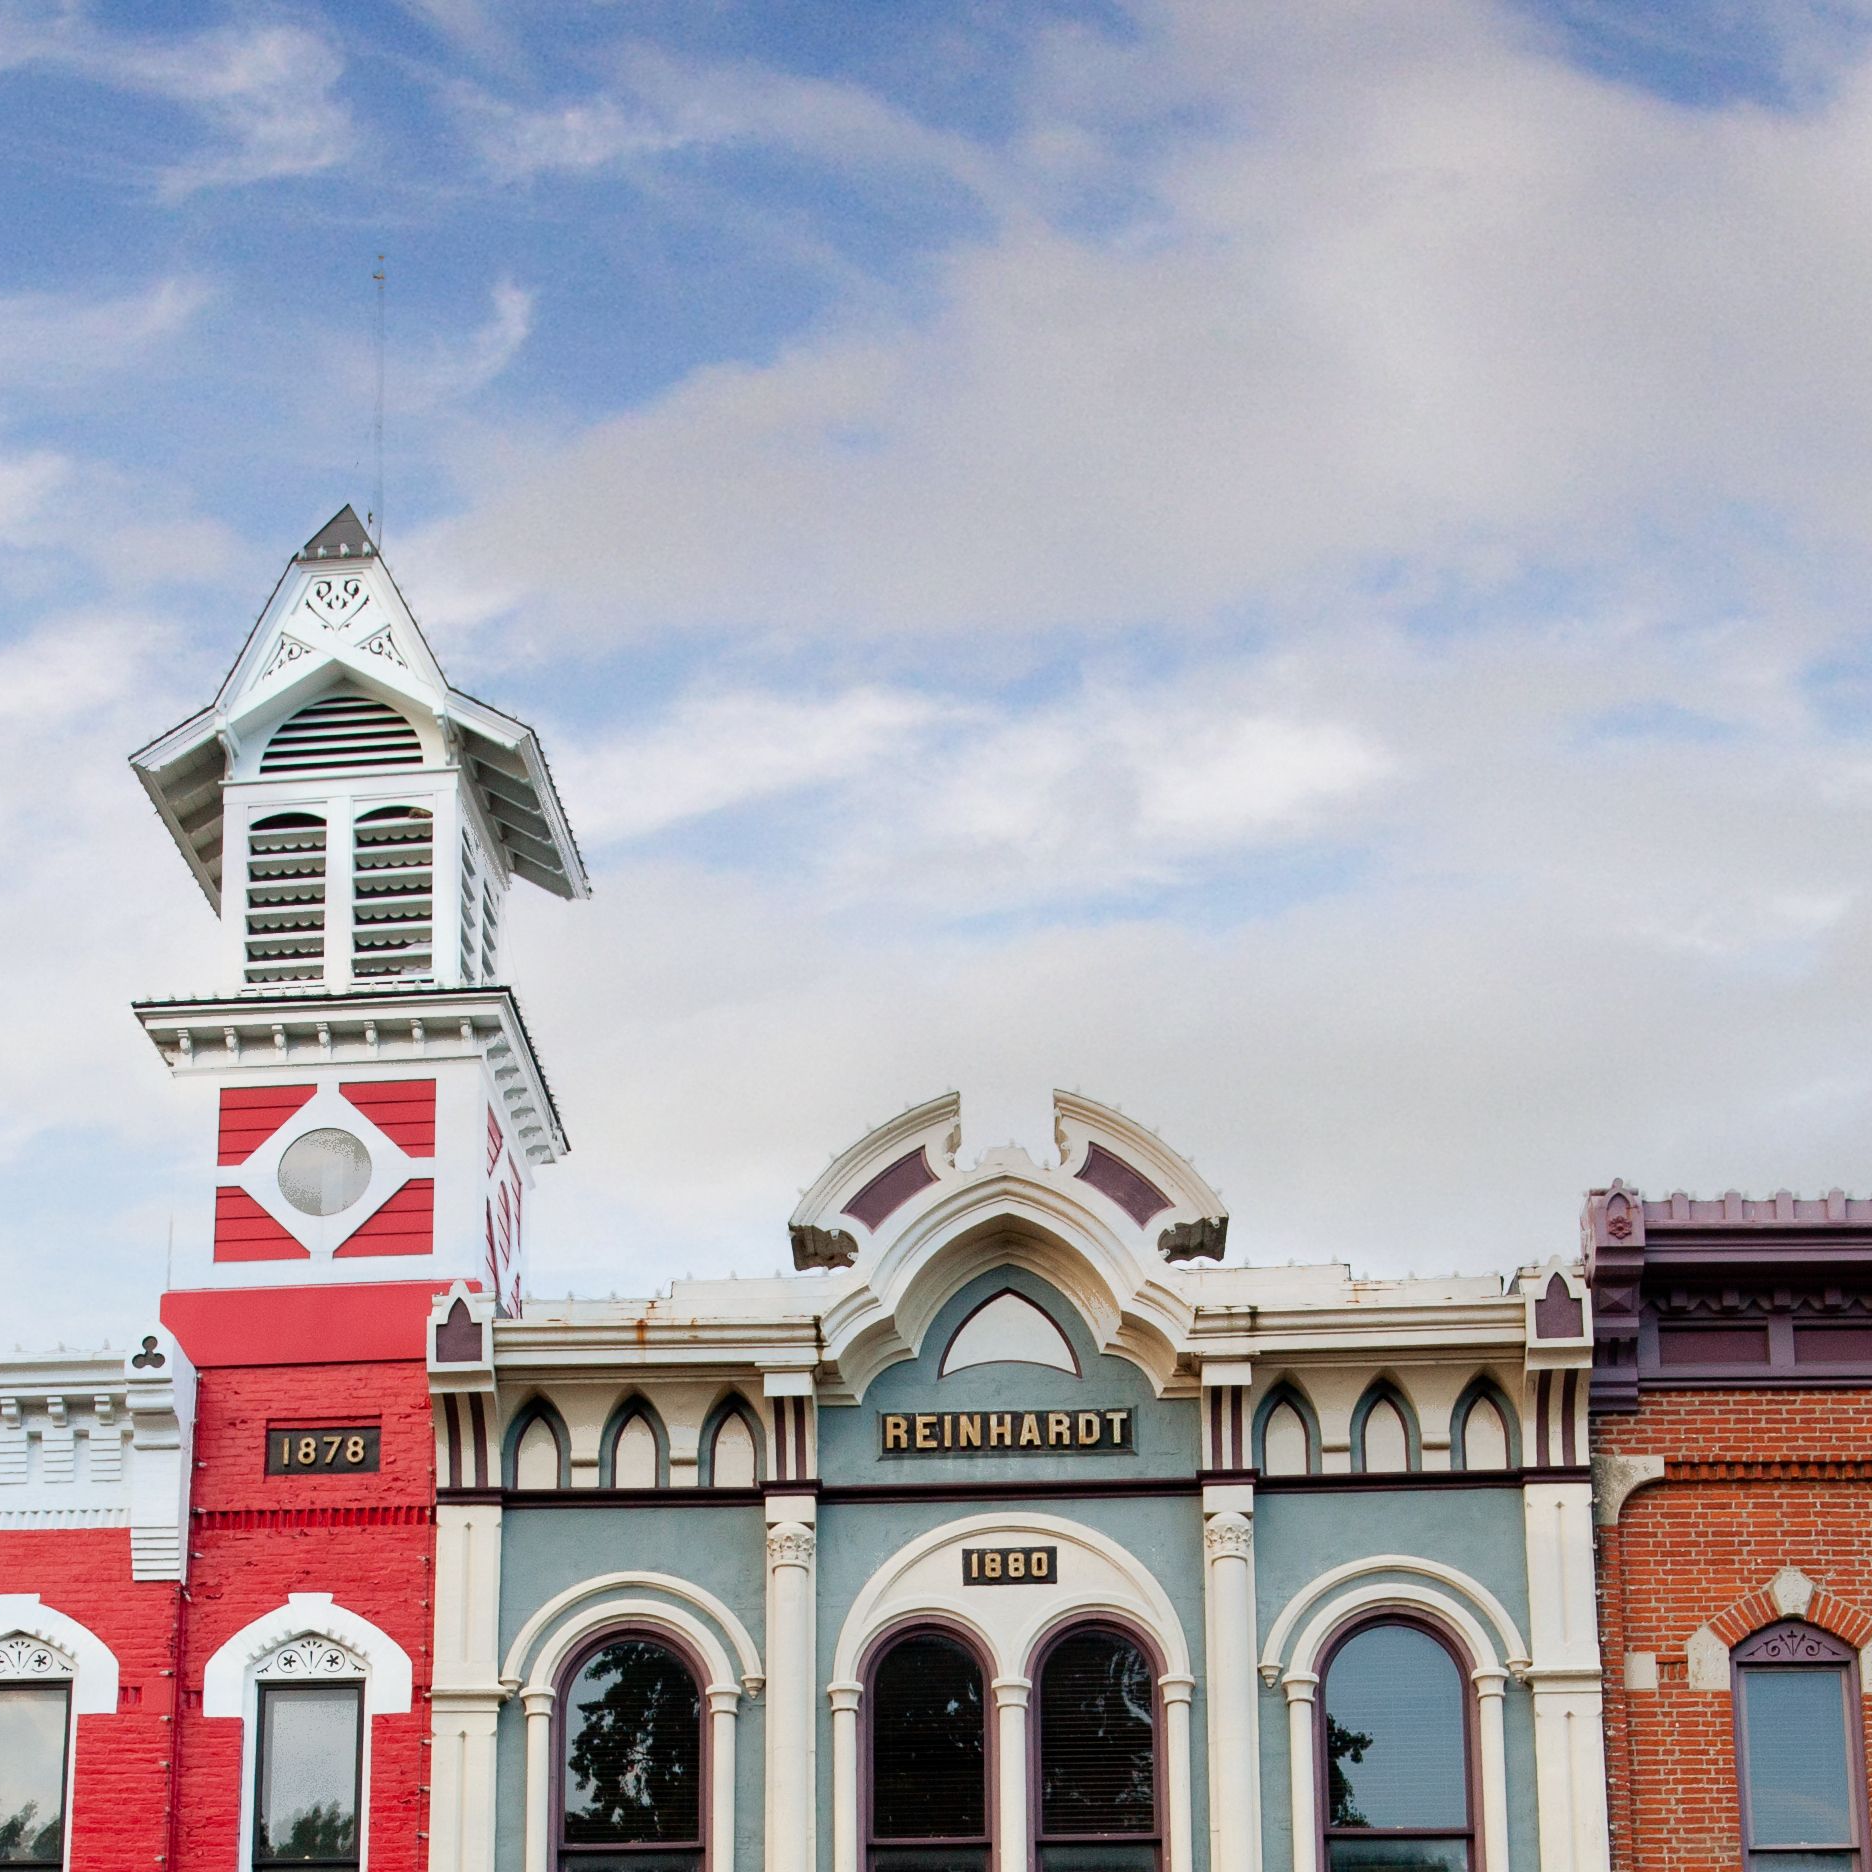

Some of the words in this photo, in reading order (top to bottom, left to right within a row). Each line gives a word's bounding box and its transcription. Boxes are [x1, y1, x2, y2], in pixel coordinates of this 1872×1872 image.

[885, 1412, 1128, 1449] REINHARDT
[282, 1436, 365, 1466] 1878
[971, 1552, 1048, 1578] 1880
